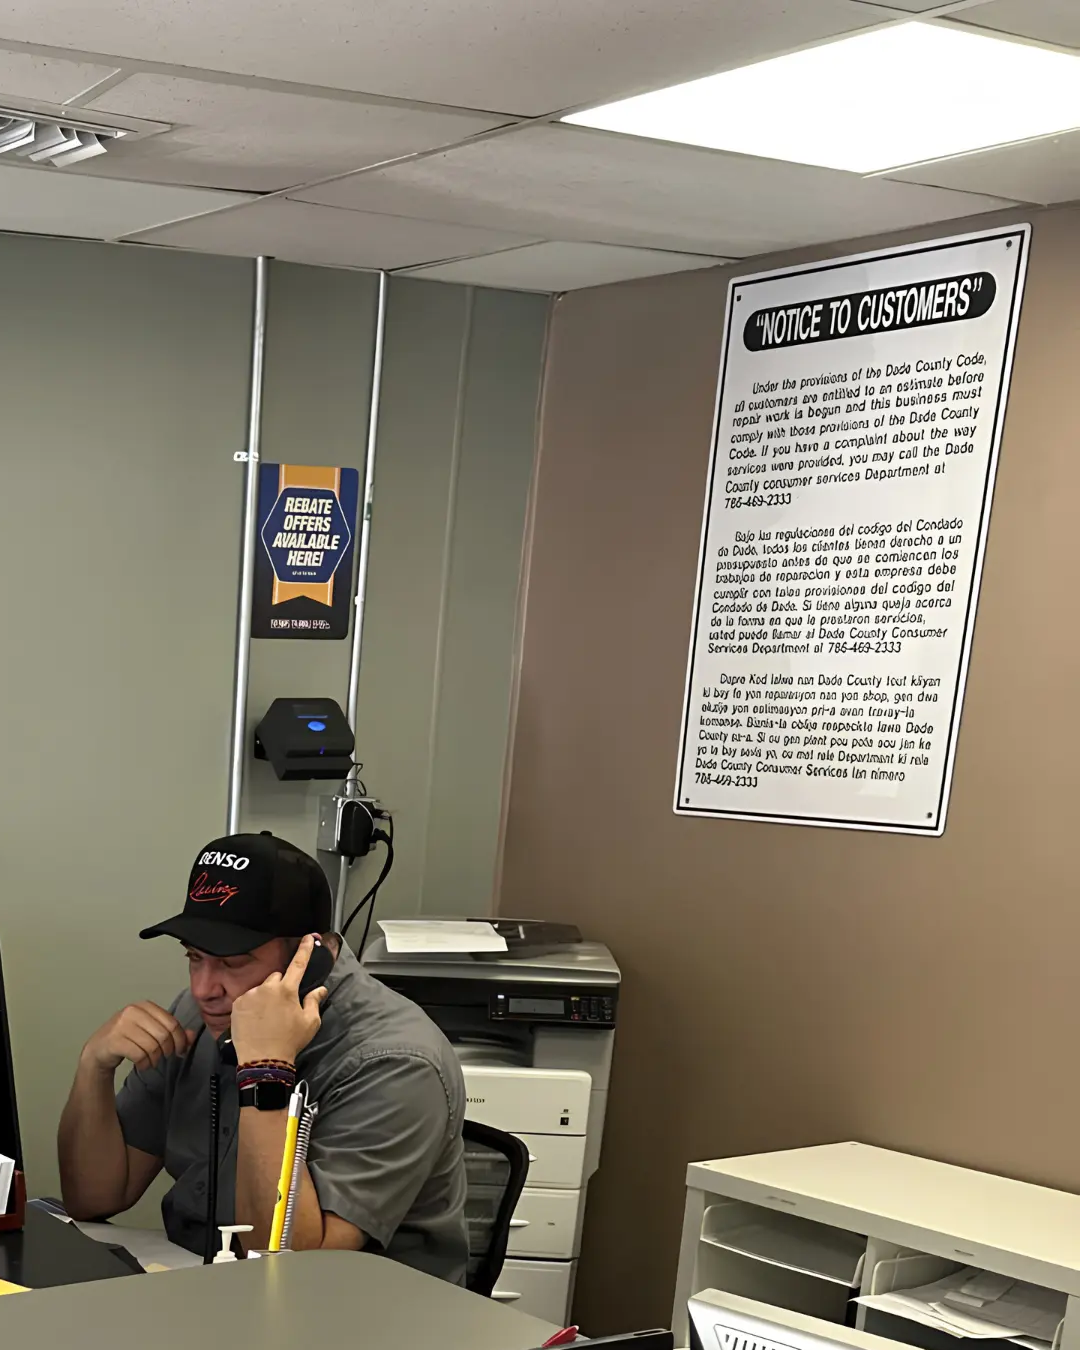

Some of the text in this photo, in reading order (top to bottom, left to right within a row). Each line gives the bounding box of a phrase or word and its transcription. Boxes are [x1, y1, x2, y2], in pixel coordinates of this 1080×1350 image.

[829, 298, 852, 336] TO
[284, 497, 334, 514] REBATE
[283, 514, 332, 533] OFFERS
[272, 532, 341, 551] AVAILABLE
[286, 550, 325, 567] HERE!
[198, 851, 250, 871] DENSO
